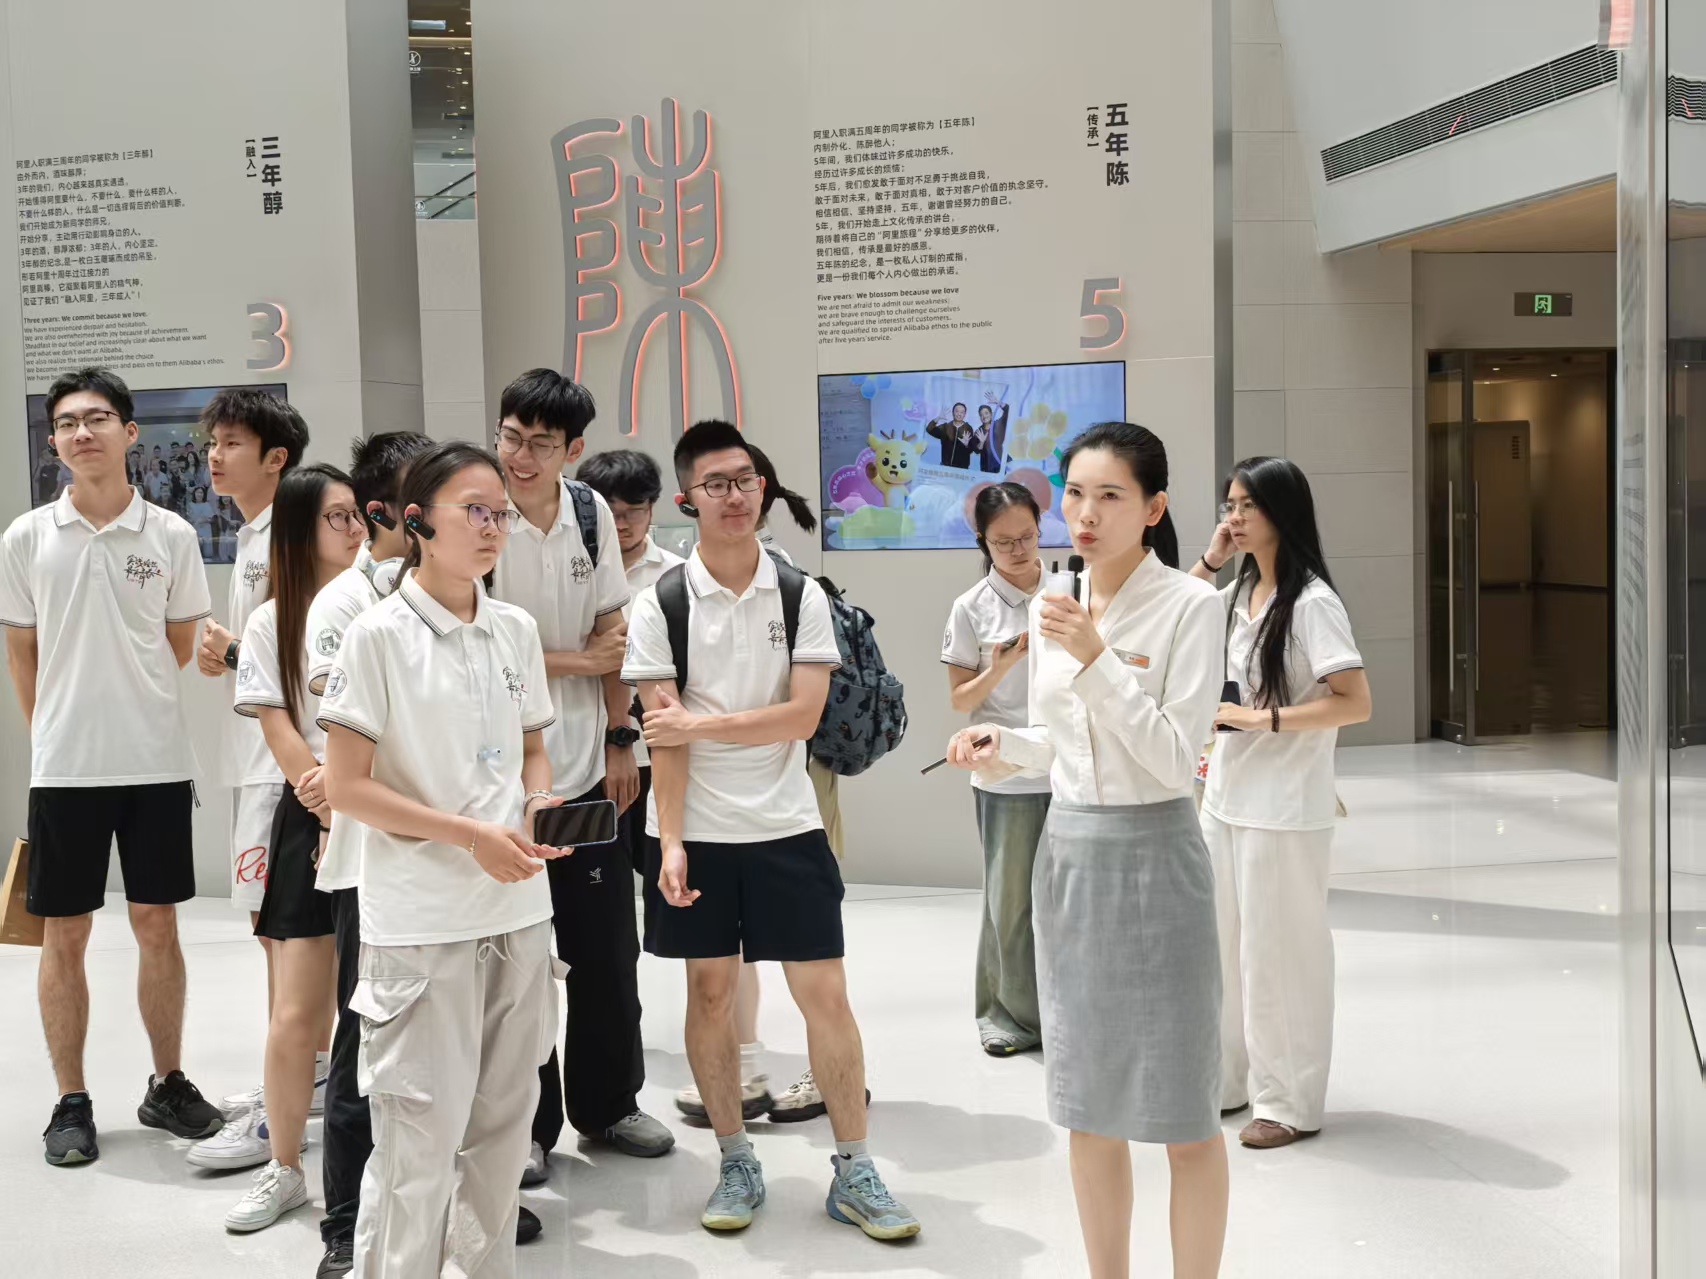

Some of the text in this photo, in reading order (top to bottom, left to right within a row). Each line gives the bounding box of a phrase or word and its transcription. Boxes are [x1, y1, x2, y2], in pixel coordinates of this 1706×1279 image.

[1106, 103, 1129, 186] 五年陈
[262, 136, 283, 214] 三年醇
[860, 309, 886, 318] enough
[895, 307, 927, 316] challenge
[929, 305, 961, 313] ourselves
[1080, 277, 1127, 350] 5
[48, 324, 82, 333] experienced
[83, 323, 104, 331] despair
[832, 319, 865, 328] safeguard
[841, 327, 870, 336] qualified
[880, 325, 902, 334] spread
[972, 320, 992, 329] public
[57, 332, 95, 340] overwhelmed
[98, 338, 131, 347] increasingly
[247, 303, 291, 371] 3
